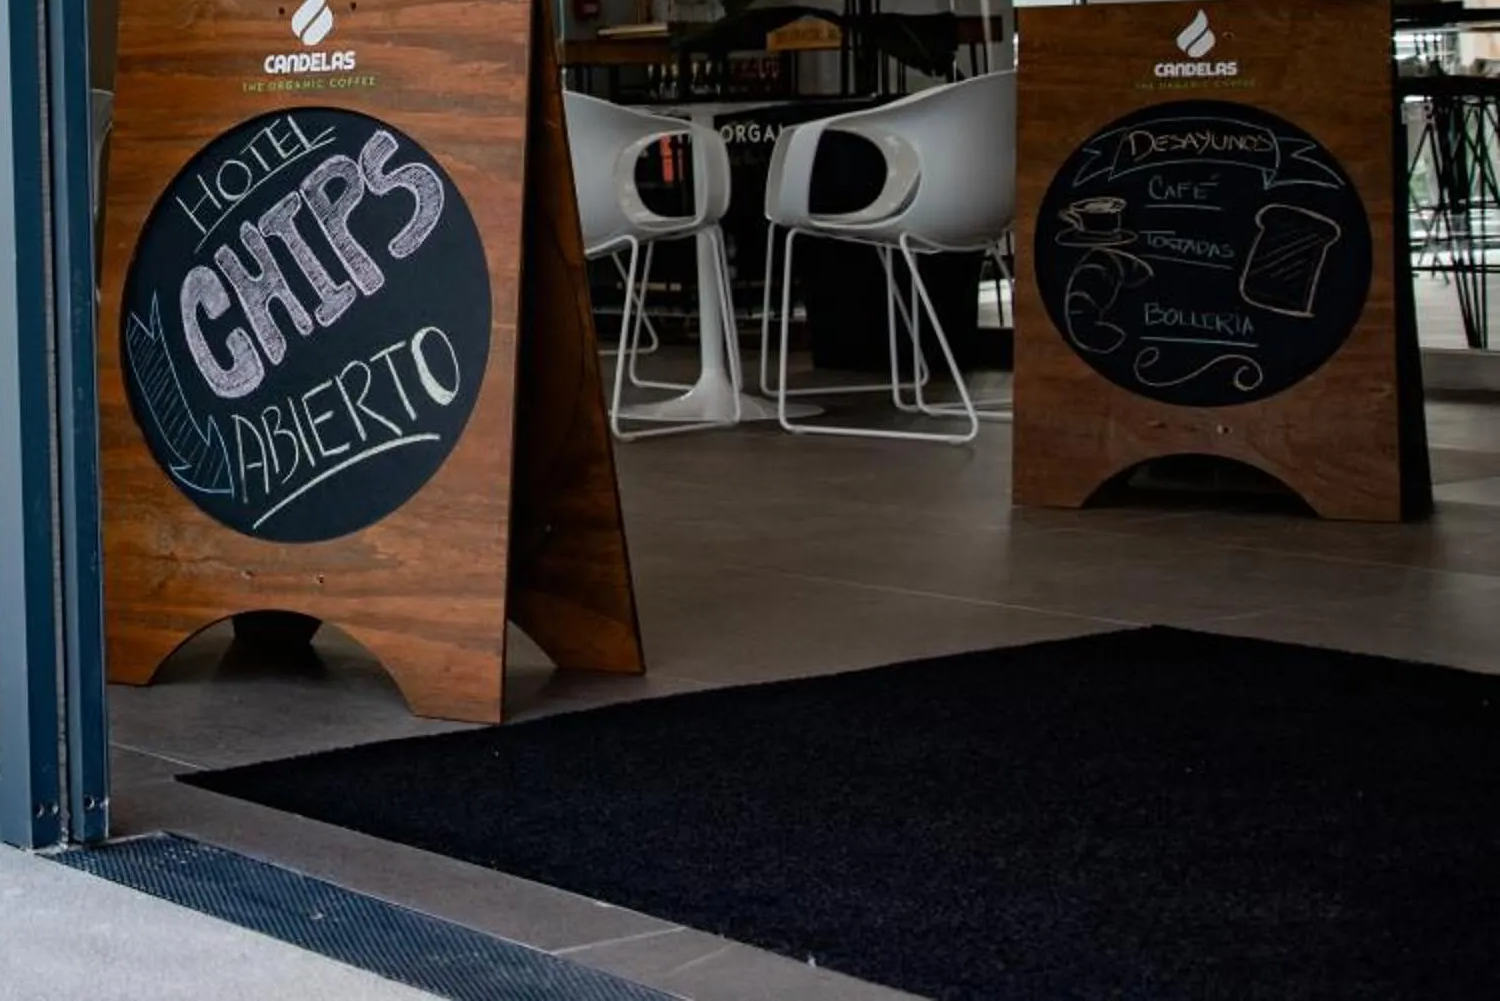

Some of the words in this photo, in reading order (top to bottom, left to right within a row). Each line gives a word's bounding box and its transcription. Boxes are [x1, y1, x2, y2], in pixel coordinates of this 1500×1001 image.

[263, 49, 357, 75] CANDELAS
[1153, 60, 1239, 79] CANDELAS
[242, 81, 263, 94] THE
[267, 78, 326, 93] ORGANIC
[328, 75, 377, 89] COFFEE
[1128, 128, 1276, 162] DESAYUNOS
[175, 112, 336, 235] HOTEL
[179, 128, 446, 399] CHIPS
[230, 326, 463, 504] ABIERTO
